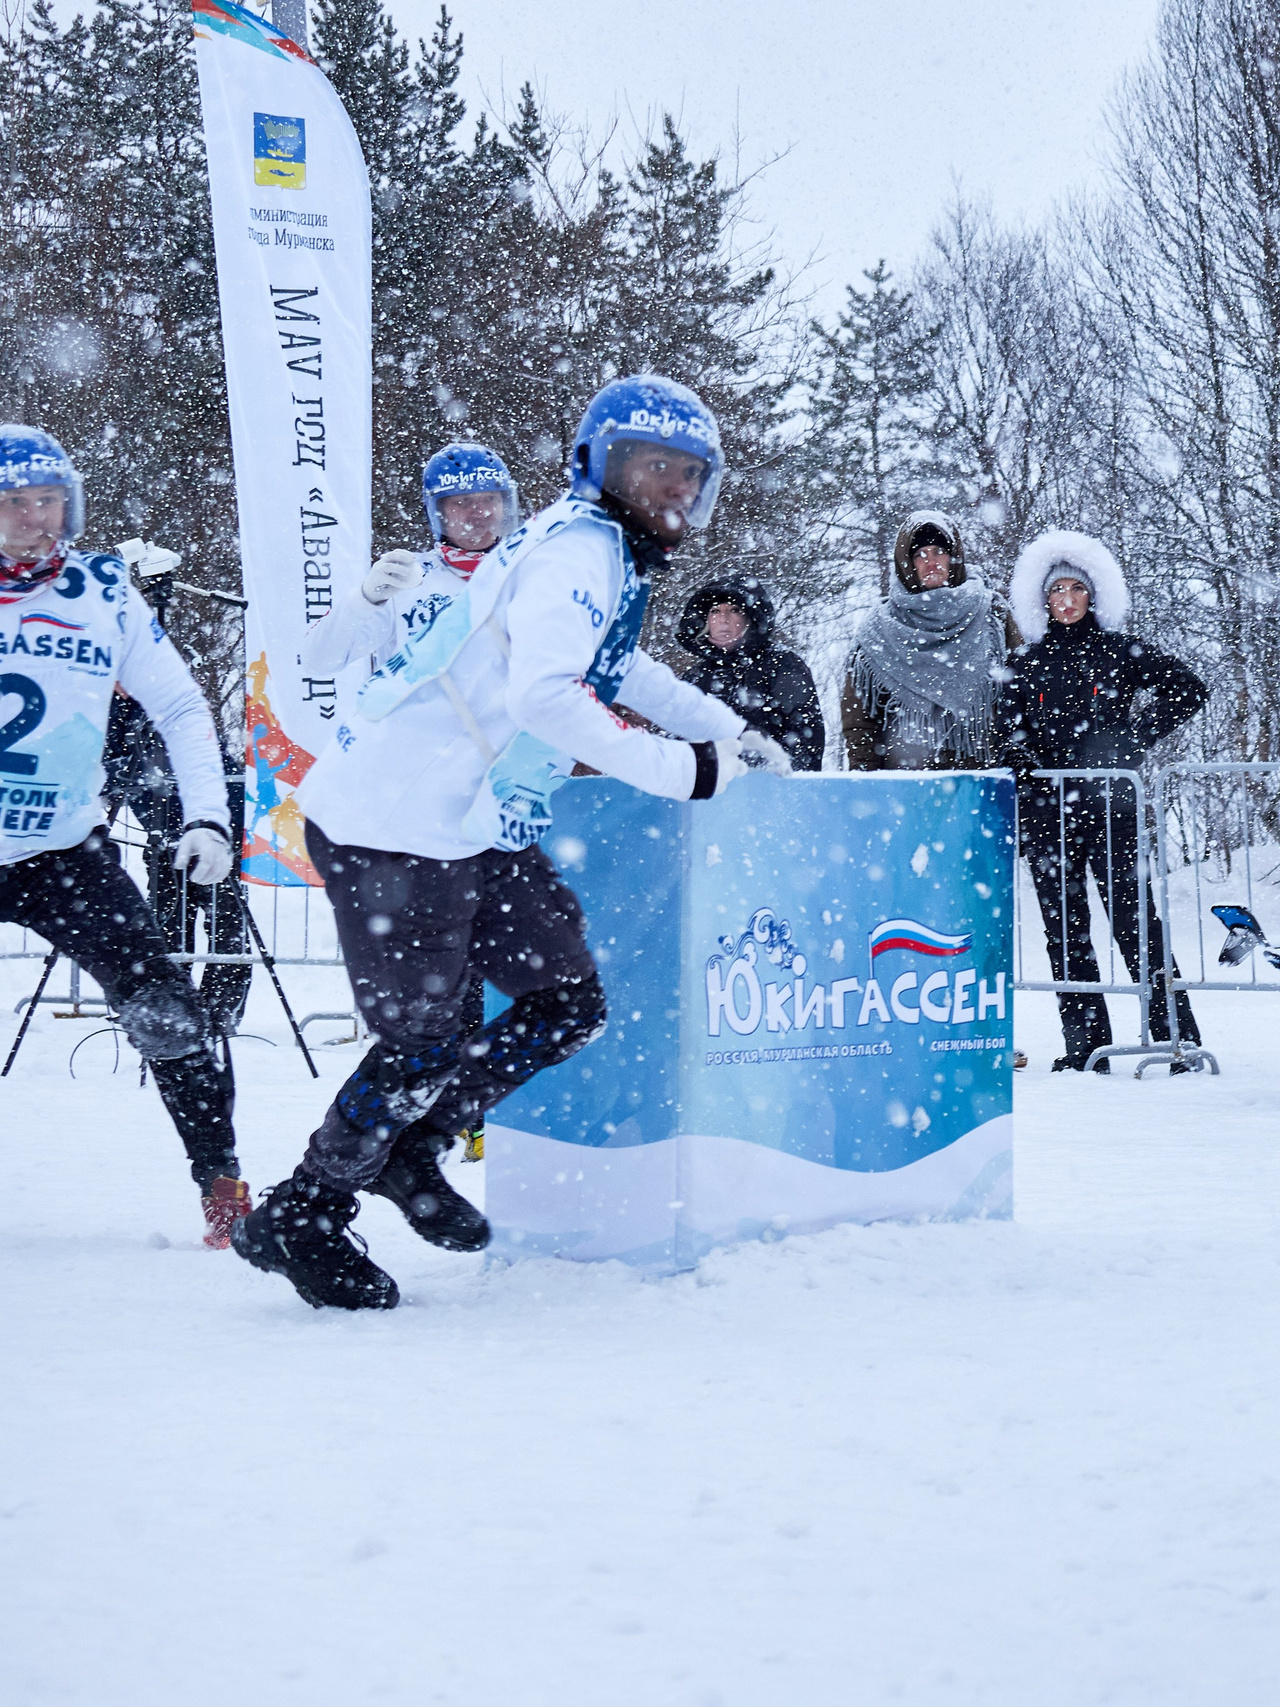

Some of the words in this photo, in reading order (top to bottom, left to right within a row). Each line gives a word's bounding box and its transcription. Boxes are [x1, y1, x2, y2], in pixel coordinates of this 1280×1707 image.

[0, 673, 47, 776] 2
[764, 1045, 838, 1063] МУРМАНСКАЯ
[841, 1043, 894, 1057] ОБЛАСТЬ
[930, 1036, 985, 1052] СНЕЖНЫЙ
[986, 1034, 1006, 1050] БОЙ
